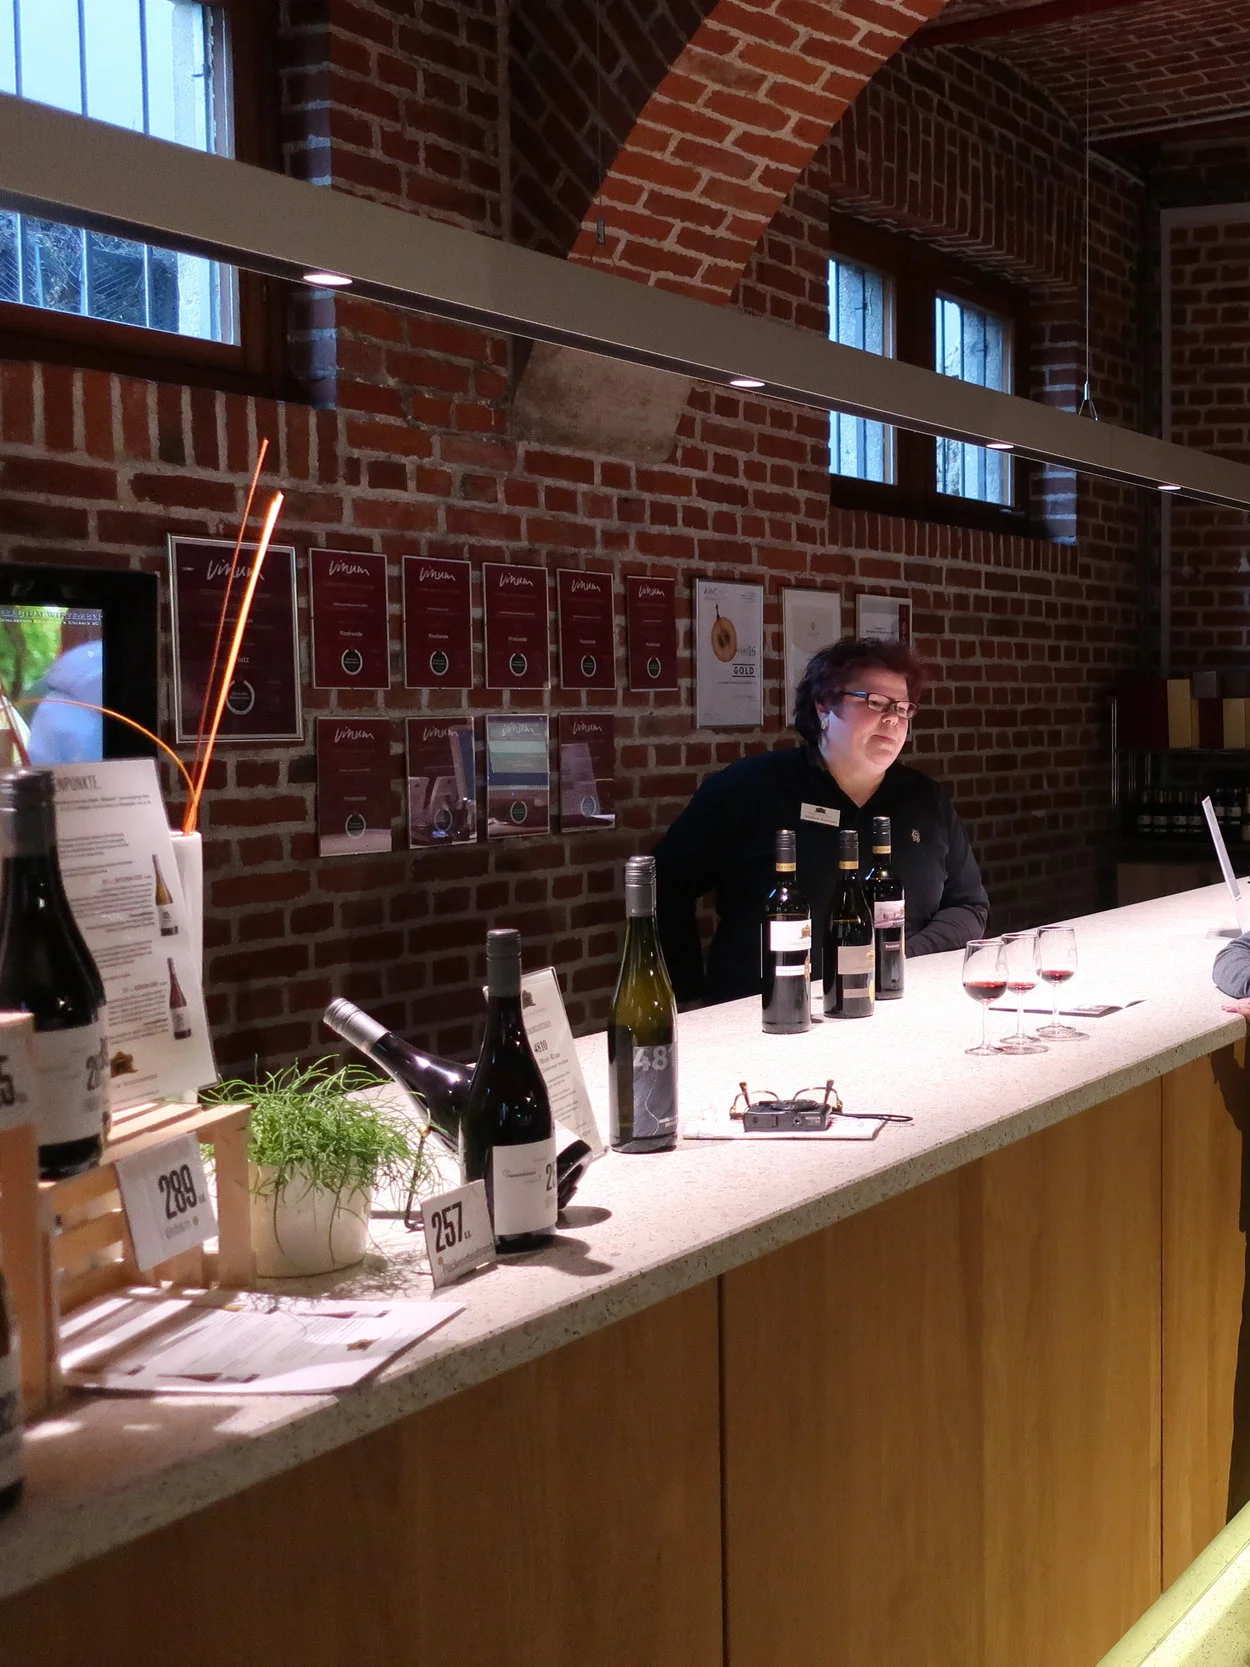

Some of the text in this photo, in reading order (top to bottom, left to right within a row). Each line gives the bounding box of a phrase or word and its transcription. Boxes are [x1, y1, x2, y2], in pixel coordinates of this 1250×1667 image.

[733, 666, 755, 675] GOLD
[158, 1164, 197, 1220] 289
[431, 1200, 462, 1253] 257
